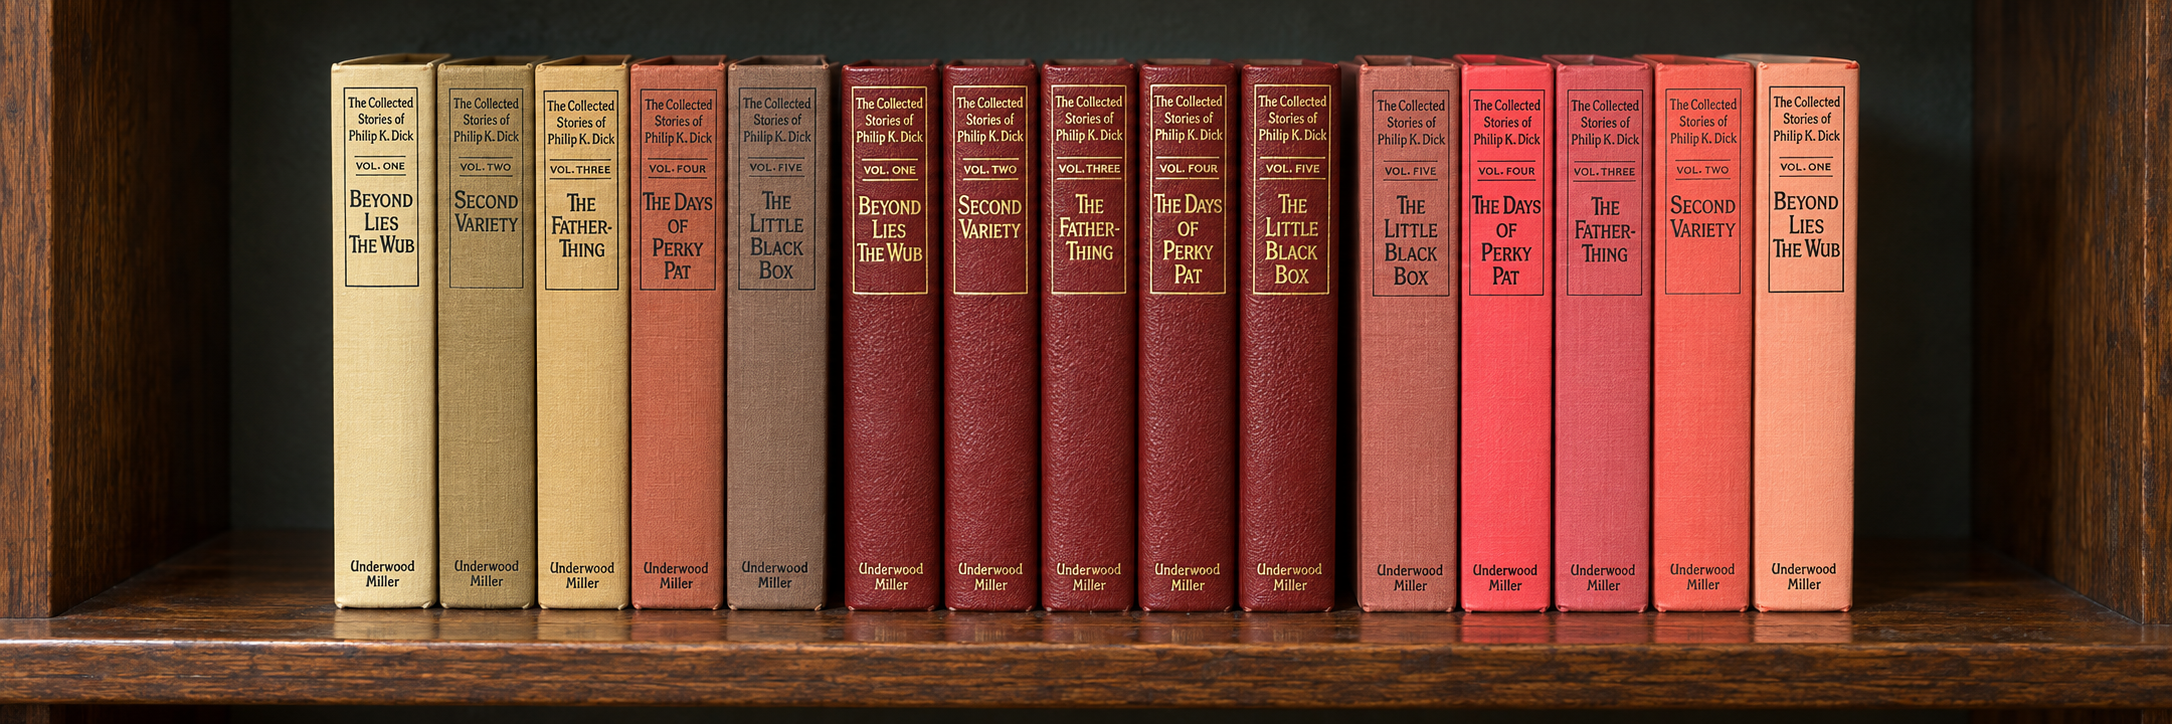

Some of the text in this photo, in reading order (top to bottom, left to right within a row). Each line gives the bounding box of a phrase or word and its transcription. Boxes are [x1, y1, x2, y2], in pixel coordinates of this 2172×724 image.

[348, 97, 413, 108] The Collected
[547, 100, 614, 111] The Collected
[856, 97, 922, 109] The Collected
[1055, 96, 1122, 107] The Collected
[1377, 100, 1445, 111] The Collected
[1571, 100, 1639, 111] The Collected
[1774, 96, 1840, 107] The Collected
[359, 113, 404, 124] Stories of
[557, 116, 606, 128] Stories of
[866, 114, 914, 126] Stories of
[1065, 112, 1114, 124] Stories of
[1387, 116, 1436, 128] Stories of
[1581, 116, 1630, 128] Stories of
[1784, 112, 1831, 124] Stories of
[349, 130, 413, 144] Philip K. Dick
[548, 133, 615, 147] Philip K. Dick
[857, 131, 923, 145] Philip K. Dick
[1056, 129, 1122, 143] Philip K. Dick
[1378, 133, 1445, 148] Philip K. Dick
[1572, 133, 1639, 148] Philip K. Dick
[1774, 130, 1840, 144] Philip K. Dick
[356, 162, 404, 170] VOL. ONE
[460, 163, 511, 171] VOL. TWO
[576, 166, 610, 174] THREE
[649, 165, 706, 173] VOL. FOUR
[864, 166, 915, 174] VOL. ONE
[964, 166, 1016, 174] VOL. TWO
[1059, 164, 1120, 173] VOL. THREE
[1160, 164, 1217, 173] VOL. FOUR
[1266, 164, 1319, 173] VOL. FIVE
[1385, 167, 1436, 175] VOL. FIVE
[1479, 167, 1534, 175] VOL. FOUR
[1574, 168, 1635, 176] VOL. THREE
[1677, 166, 1729, 174] VOL. TWO
[1781, 163, 1831, 171] VOL. ONE
[350, 190, 413, 207] BEYOND
[455, 190, 518, 209] SECOND
[567, 193, 596, 211] THE
[643, 192, 712, 210] THE DAYS
[762, 191, 791, 209] THE
[859, 196, 921, 215] BEYOND
[958, 195, 1021, 215] SECOND
[1075, 194, 1103, 213] THE
[1154, 193, 1222, 213] THE DAYS
[1278, 194, 1307, 213] THE
[1397, 195, 1425, 214] THE
[1472, 195, 1541, 214] THE DAYS
[1671, 195, 1735, 214] SECOND
[1774, 192, 1838, 210] BEYOND
[1591, 197, 1619, 215] THE
[365, 213, 398, 231] LIES
[455, 213, 518, 232] VARIETY
[552, 216, 612, 234] FATHER-
[668, 219, 688, 233] OF
[750, 213, 803, 232] LITTLE
[872, 219, 906, 238] LIES
[959, 219, 1020, 239] VARIETY
[1059, 217, 1119, 237] FATHER-
[1178, 221, 1198, 236] OF
[1265, 217, 1318, 237] LITTLE
[1385, 219, 1437, 238] LITTLE
[1670, 219, 1736, 237] VARIETY
[1790, 215, 1824, 234] LIES
[1496, 223, 1517, 238] OF
[1575, 220, 1635, 239] FATHER-
[349, 235, 414, 253] THE WUB
[559, 239, 604, 257] THING
[653, 238, 703, 256] PERKY
[751, 237, 803, 255] BLACK
[1066, 241, 1113, 260] THING
[1163, 240, 1213, 260] PERKY
[1265, 241, 1317, 260] BLACK
[1773, 239, 1840, 257] THE WUB
[857, 243, 922, 262] THE WUB
[1385, 243, 1437, 261] BLACK
[1482, 243, 1532, 261] PERKY
[1582, 244, 1627, 262] THING
[665, 261, 691, 279] PAT
[759, 260, 793, 279] BOX
[1175, 264, 1202, 284] PAT
[1275, 265, 1309, 284] BOX
[1394, 267, 1428, 285] BOX
[1493, 266, 1519, 285] PAT
[455, 560, 518, 571] Underwood
[644, 562, 708, 574] Underwood
[742, 561, 808, 573] Underwood
[959, 563, 1022, 575] Underwood
[1155, 563, 1220, 576] Underwood
[1257, 563, 1322, 575] Underwood
[1473, 564, 1537, 576] Underwood
[1671, 563, 1734, 575] Underwood
[470, 575, 503, 586] Miller
[660, 577, 693, 589] Miller
[758, 577, 792, 588] Miller
[974, 579, 1007, 590] Miller
[1171, 579, 1205, 591] Miller
[1274, 579, 1307, 591] Miller
[1489, 579, 1522, 591] Miller
[1687, 578, 1719, 590] Miller
